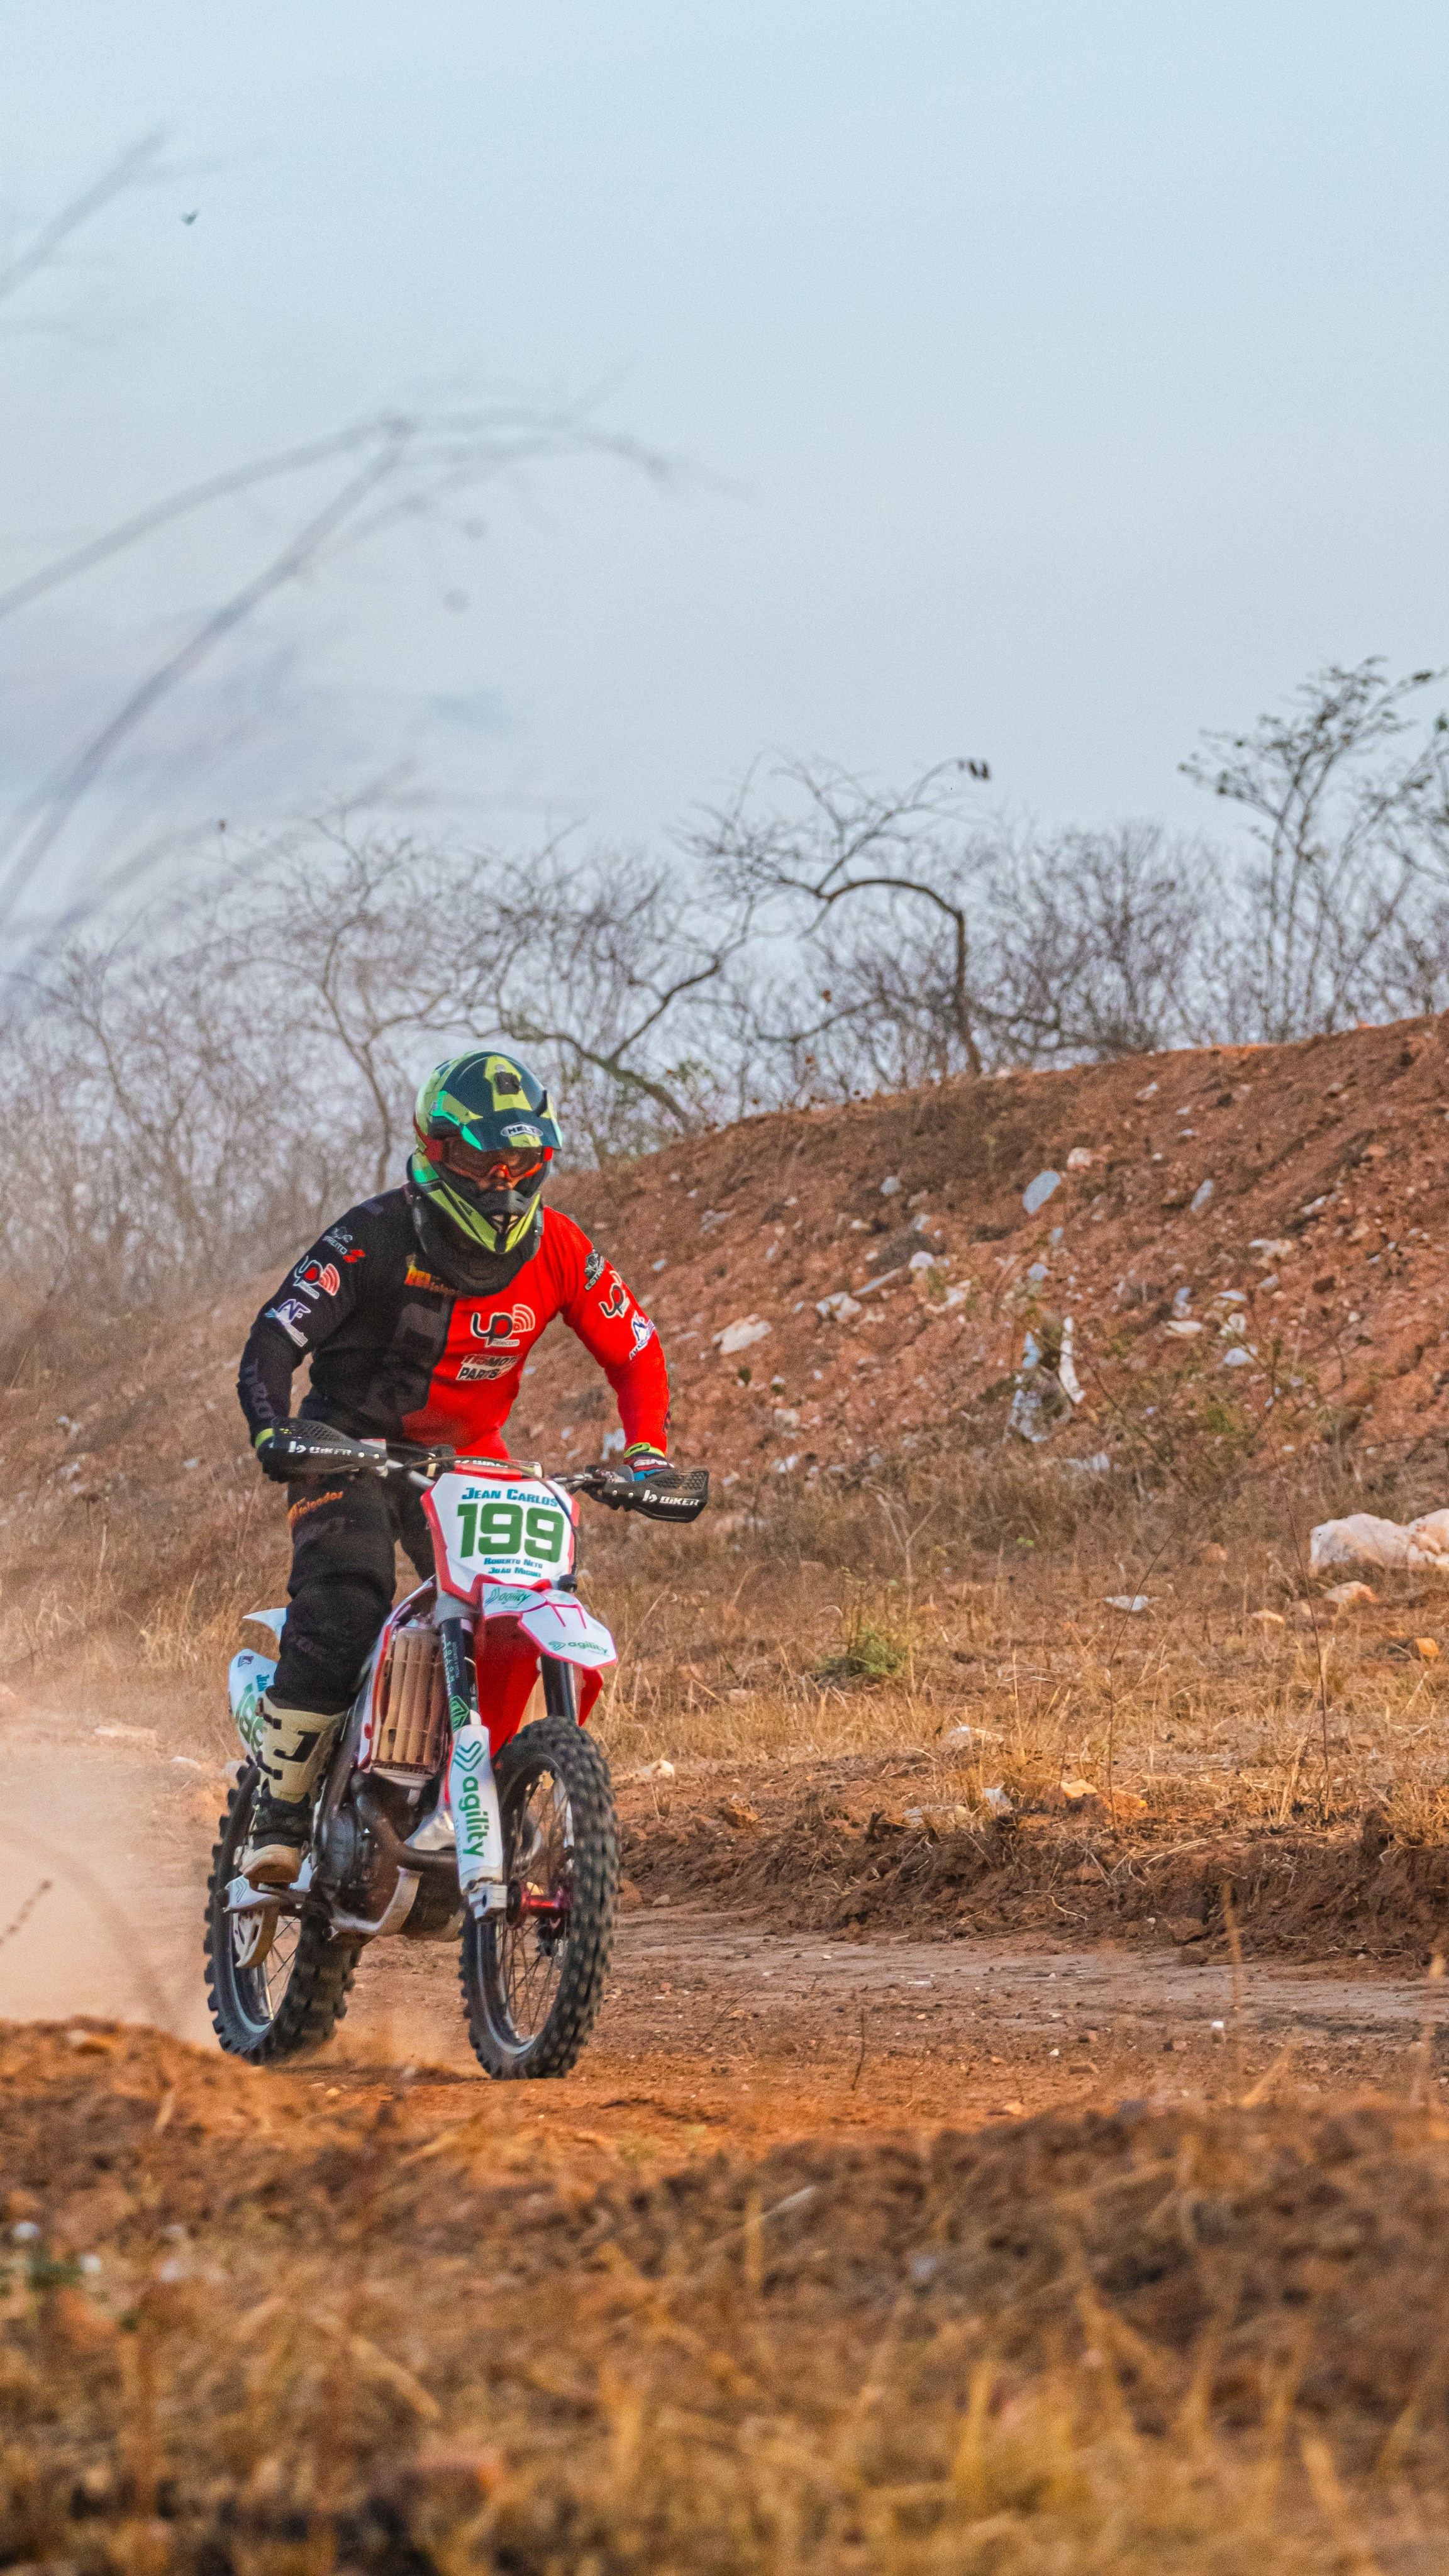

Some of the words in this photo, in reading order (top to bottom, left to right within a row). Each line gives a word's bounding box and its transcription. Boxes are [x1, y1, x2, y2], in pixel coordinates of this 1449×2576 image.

[470, 1312, 513, 1347] up
[462, 1487, 501, 1500] JEAN
[506, 1489, 558, 1507] CARLOS
[457, 1503, 565, 1563] 199
[568, 1641, 608, 1655] agility
[458, 1775, 489, 1857] agility
